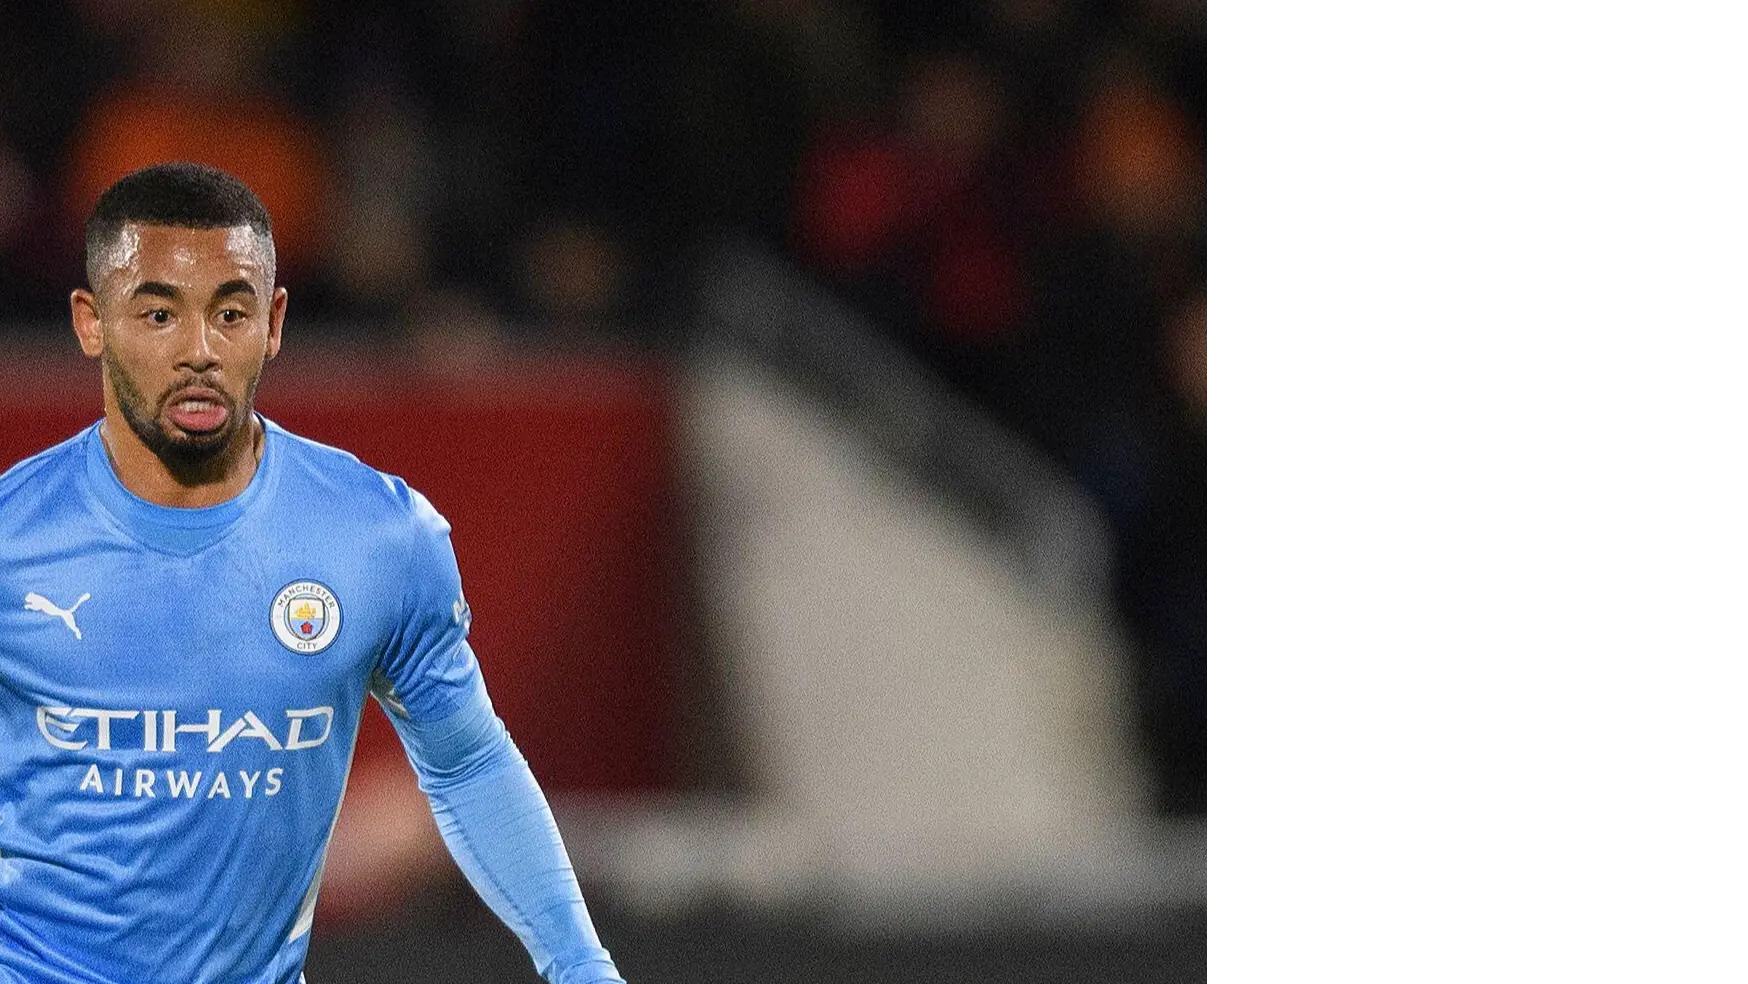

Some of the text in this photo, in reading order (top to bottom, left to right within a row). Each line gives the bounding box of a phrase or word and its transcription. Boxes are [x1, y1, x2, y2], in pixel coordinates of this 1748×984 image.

[278, 584, 335, 609] MANCHESTER
[296, 641, 318, 650] CITY
[36, 706, 334, 752] ETIHAD
[79, 764, 285, 799] AIRWAYS
